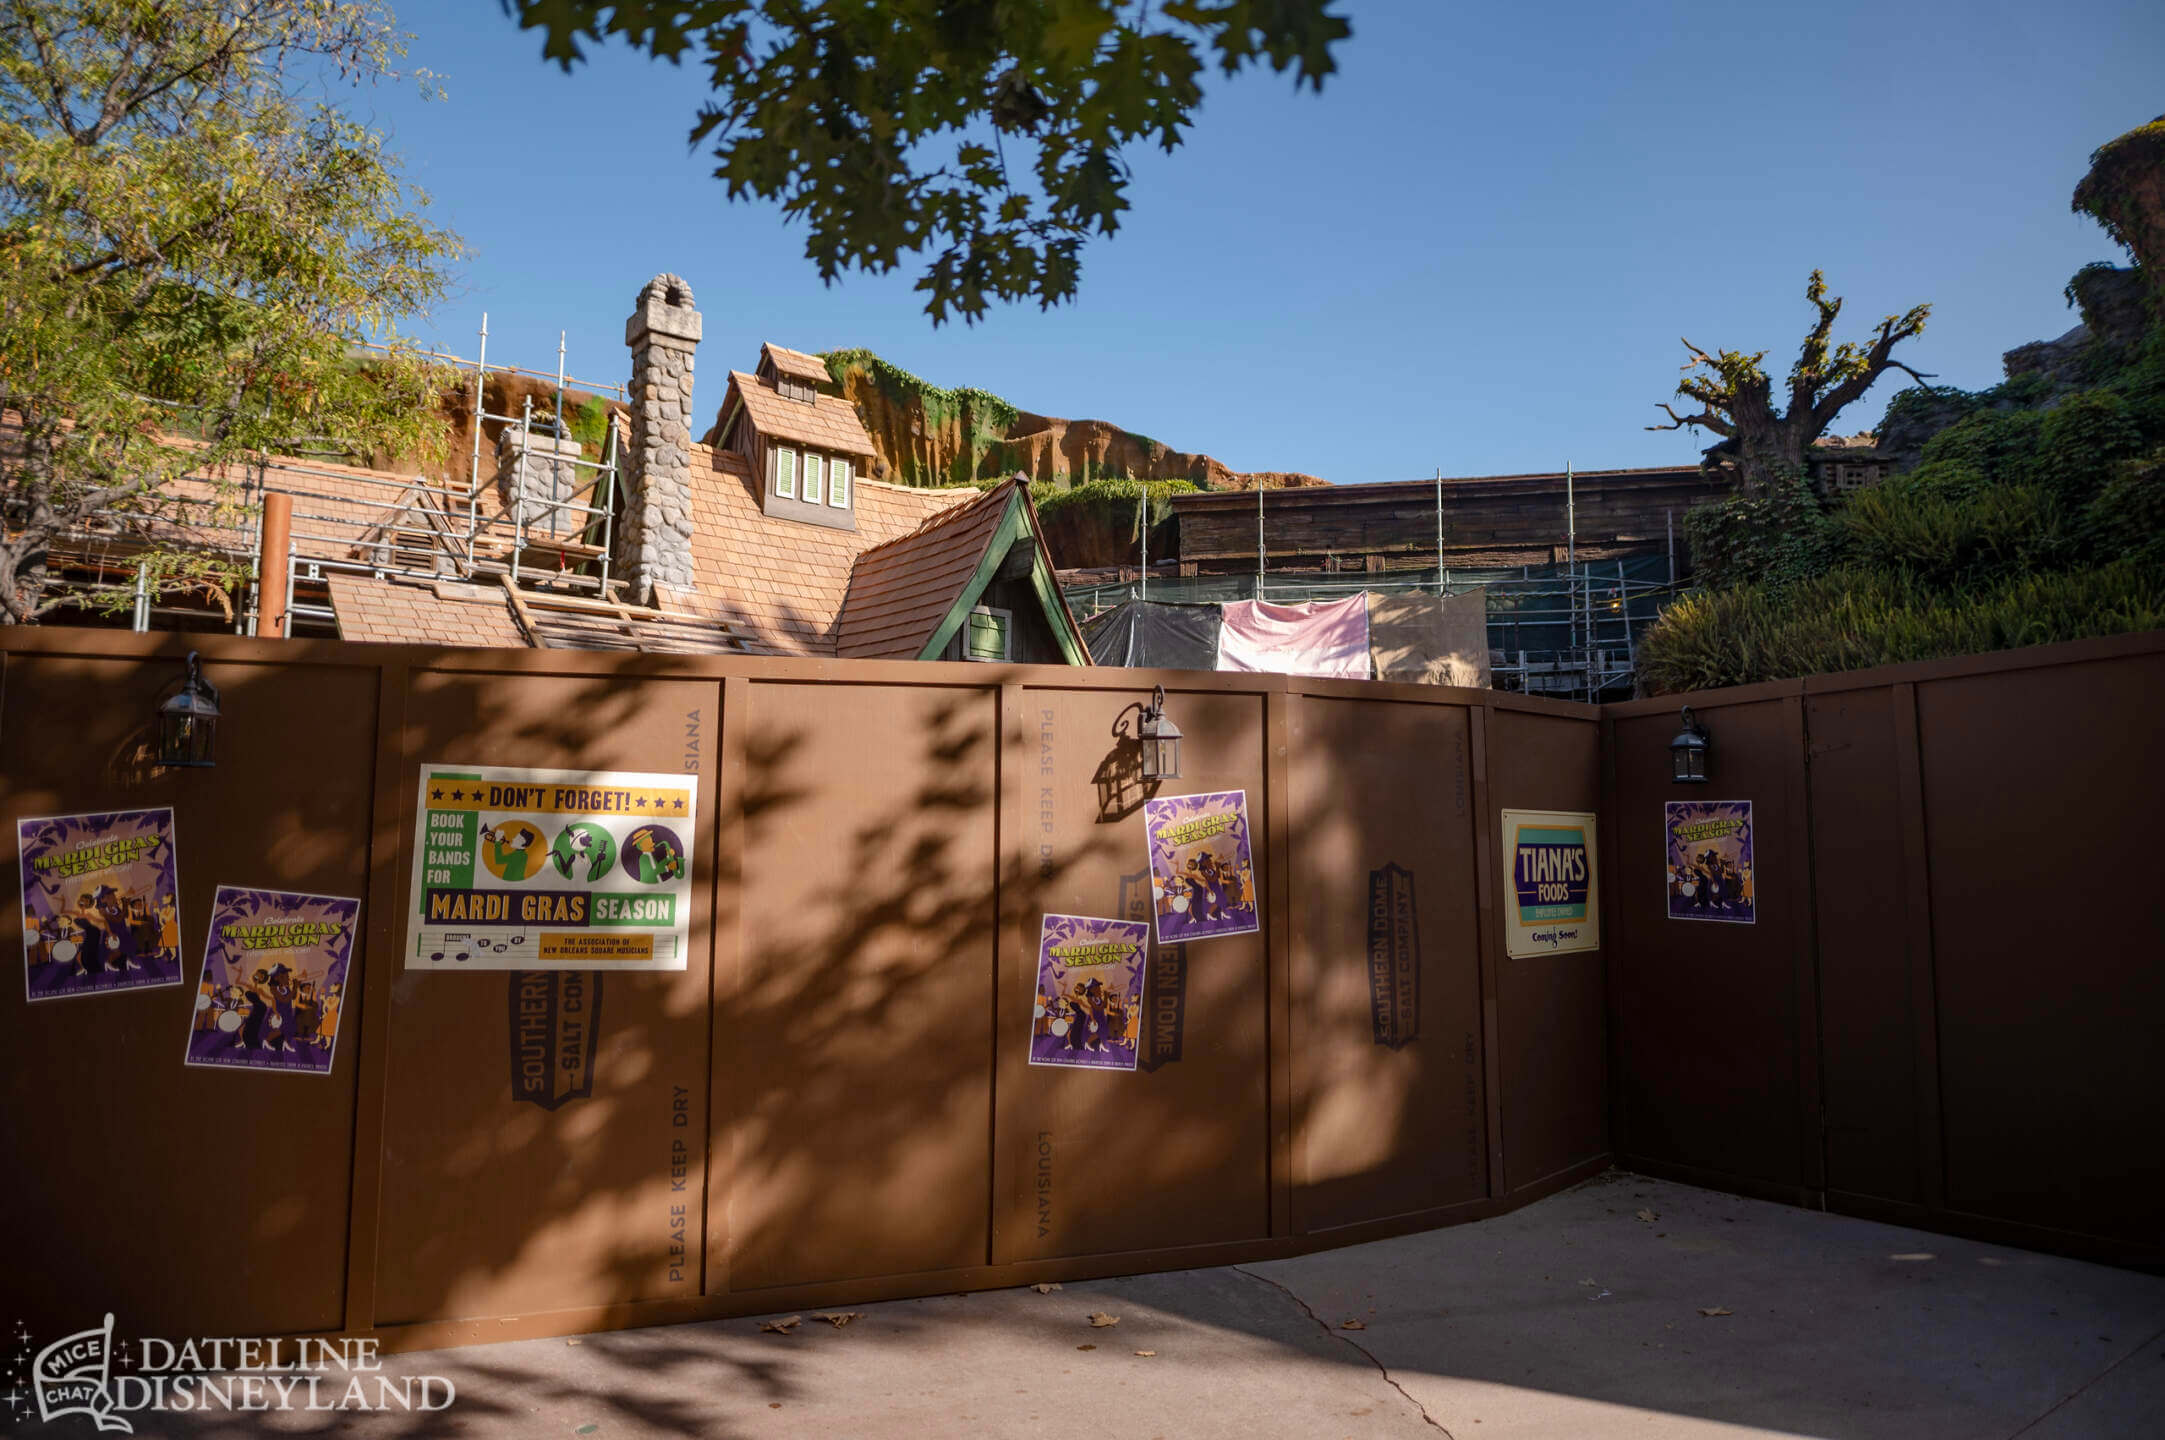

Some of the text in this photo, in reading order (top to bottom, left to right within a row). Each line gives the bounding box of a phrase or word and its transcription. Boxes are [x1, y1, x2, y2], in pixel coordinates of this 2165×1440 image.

[684, 708, 700, 775] SIANA
[1040, 709, 1054, 777] PLEASE
[489, 786, 631, 812] DON'T FORGET!
[1040, 786, 1054, 833] KEEP
[431, 813, 464, 828] BOOK
[1156, 821, 1200, 840] MARDI
[1202, 812, 1238, 828] GRAS
[1672, 823, 1709, 836] MARDI
[1711, 818, 1744, 831] GRAS
[430, 831, 463, 846] YOUR
[1173, 824, 1225, 847] SEASON
[1686, 829, 1732, 842] SEASON
[33, 833, 161, 871] MARDI GRAS
[58, 849, 140, 879] SEASON
[428, 851, 471, 866] BANDS
[1519, 847, 1585, 883] TIANA'S
[426, 869, 451, 884] FOR
[1538, 883, 1569, 902] FOODS
[430, 893, 670, 922] MARDI GRAS SEASON
[221, 922, 343, 938] MARDI GRAS
[242, 935, 321, 950] SEASON
[1532, 927, 1578, 948] Coming Soon!
[543, 946, 557, 954] NEW
[1049, 943, 1137, 957] MARDI GRAS
[1065, 953, 1122, 967] SEASON
[1373, 878, 1392, 1039] SOUTHERN DOME
[1396, 890, 1412, 1019] SALT COMPANY
[520, 970, 549, 1091] SOUTHERN
[1157, 1001, 1178, 1055] DOME
[561, 1020, 582, 1071] SALT
[669, 1085, 689, 1282] PLEASE KEEP DRY
[1037, 1130, 1051, 1240] LOUISIANA
